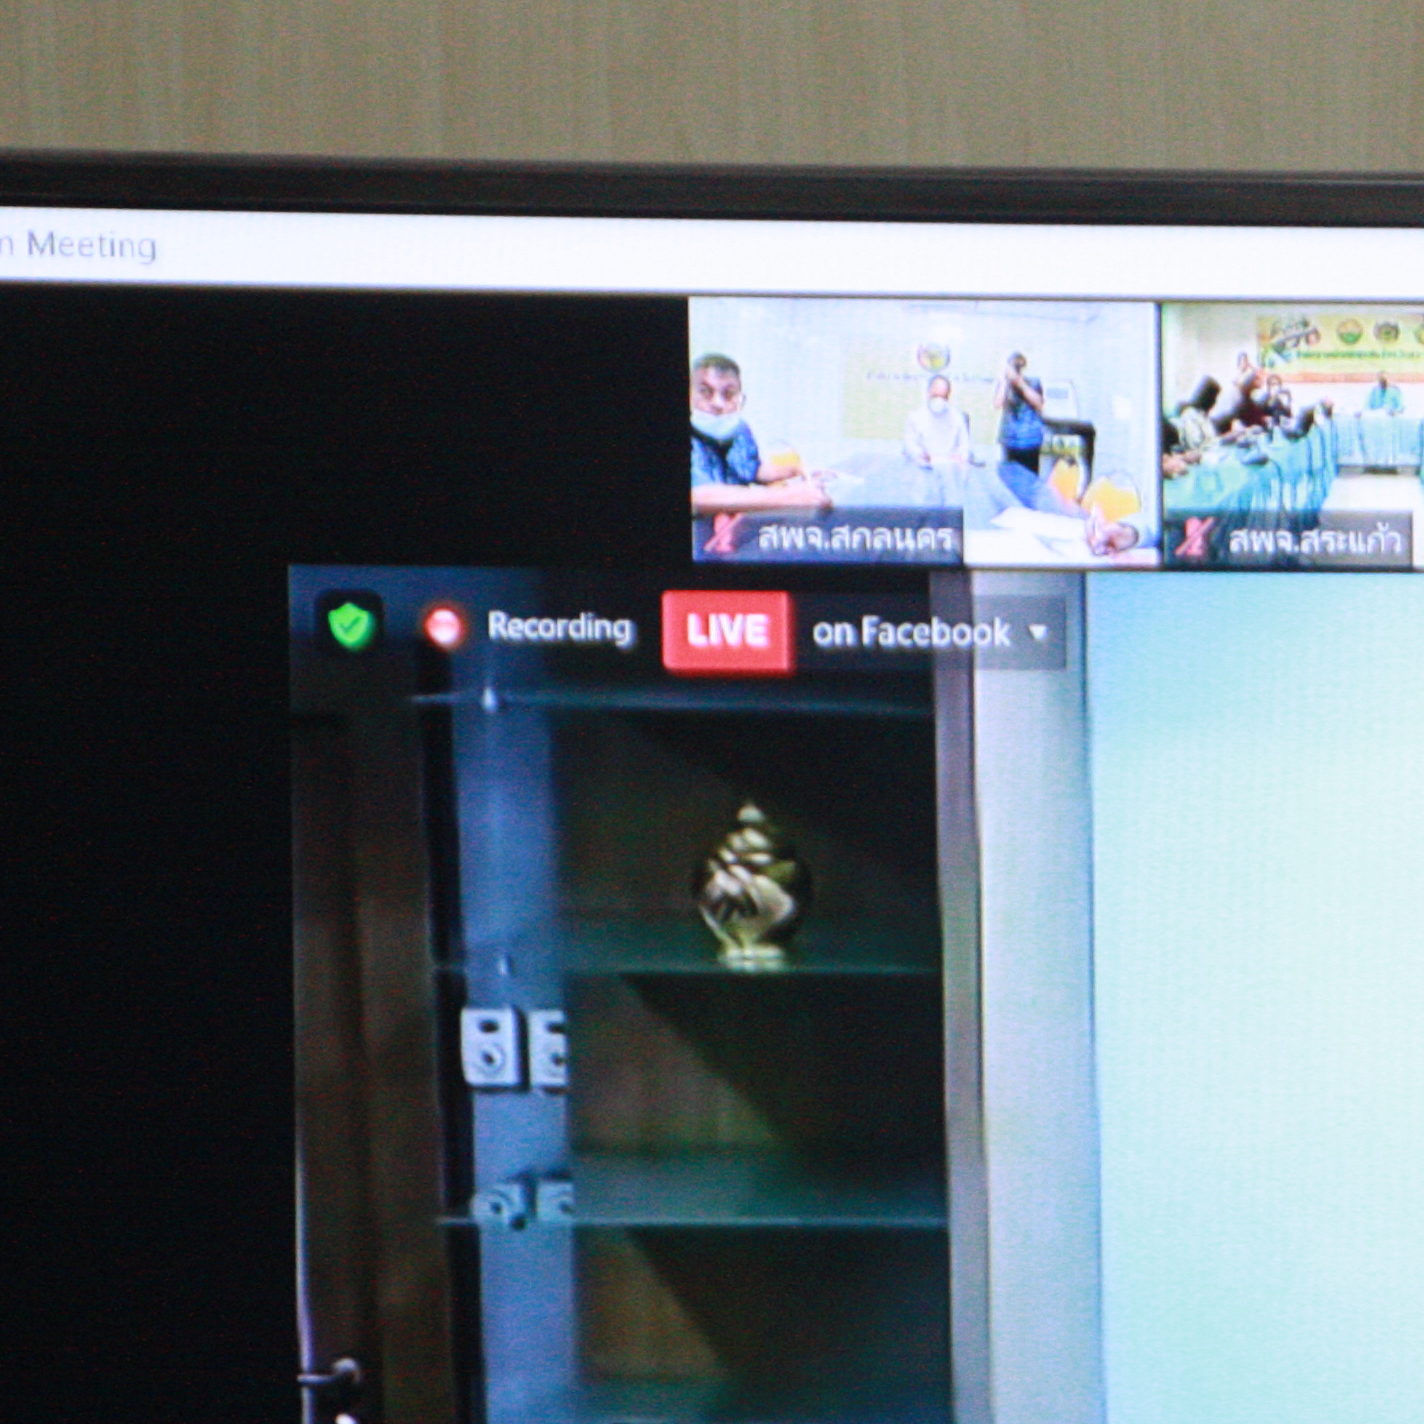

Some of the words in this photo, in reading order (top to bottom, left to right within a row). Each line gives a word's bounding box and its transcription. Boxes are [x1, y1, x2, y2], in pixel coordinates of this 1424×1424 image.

[28, 229, 157, 265] Meeting
[1229, 521, 1402, 556] สพจ.สระแก้ว
[488, 609, 635, 648] Recording
[686, 612, 769, 648] LIVE
[812, 626, 857, 646] on
[862, 615, 1011, 649] Facebook
